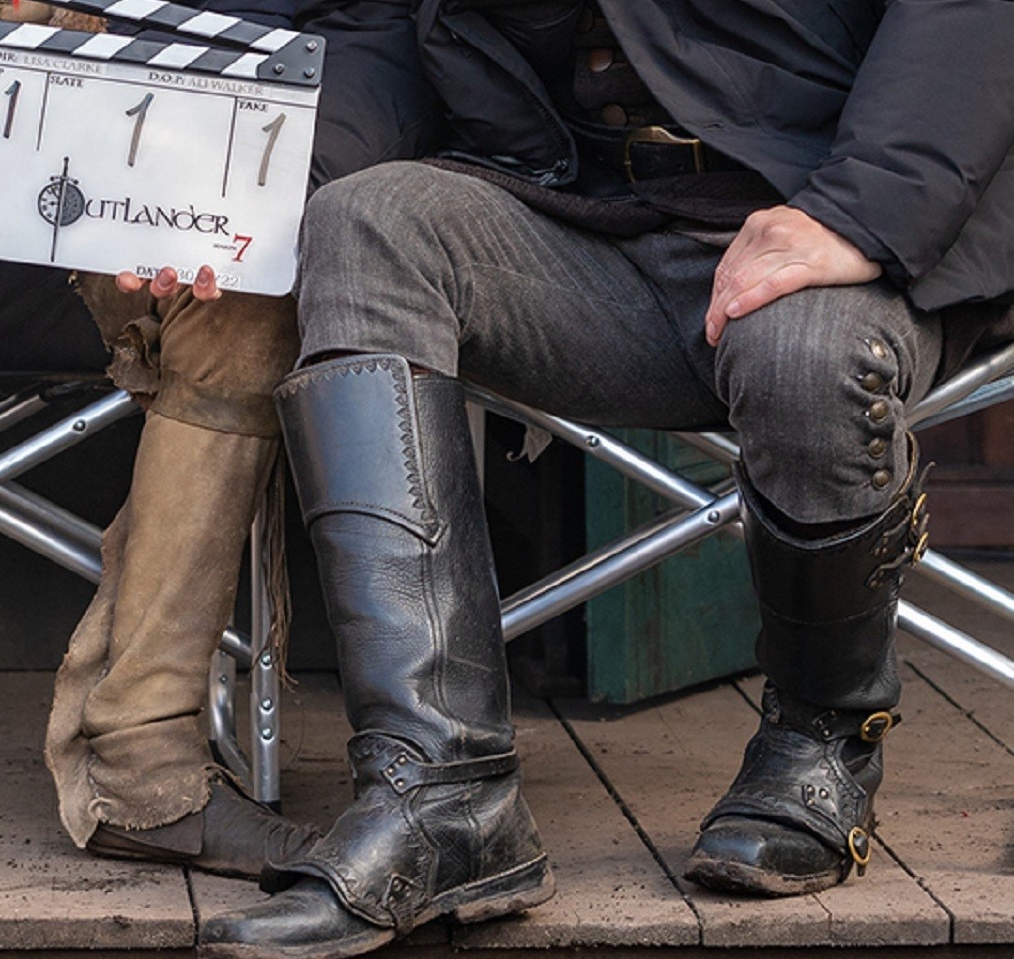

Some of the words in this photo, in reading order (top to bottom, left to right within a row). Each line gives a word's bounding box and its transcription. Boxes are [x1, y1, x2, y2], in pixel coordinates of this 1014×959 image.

[23, 55, 50, 69] LISA
[52, 60, 103, 74] CLARKE
[49, 75, 85, 89] SLATE
[188, 77, 208, 90] ALI
[211, 80, 265, 96] WALKER
[4, 80, 22, 139] 1
[238, 100, 269, 113] TAKE
[125, 92, 155, 168] 1
[258, 112, 287, 187] 1
[232, 233, 253, 263] 7
